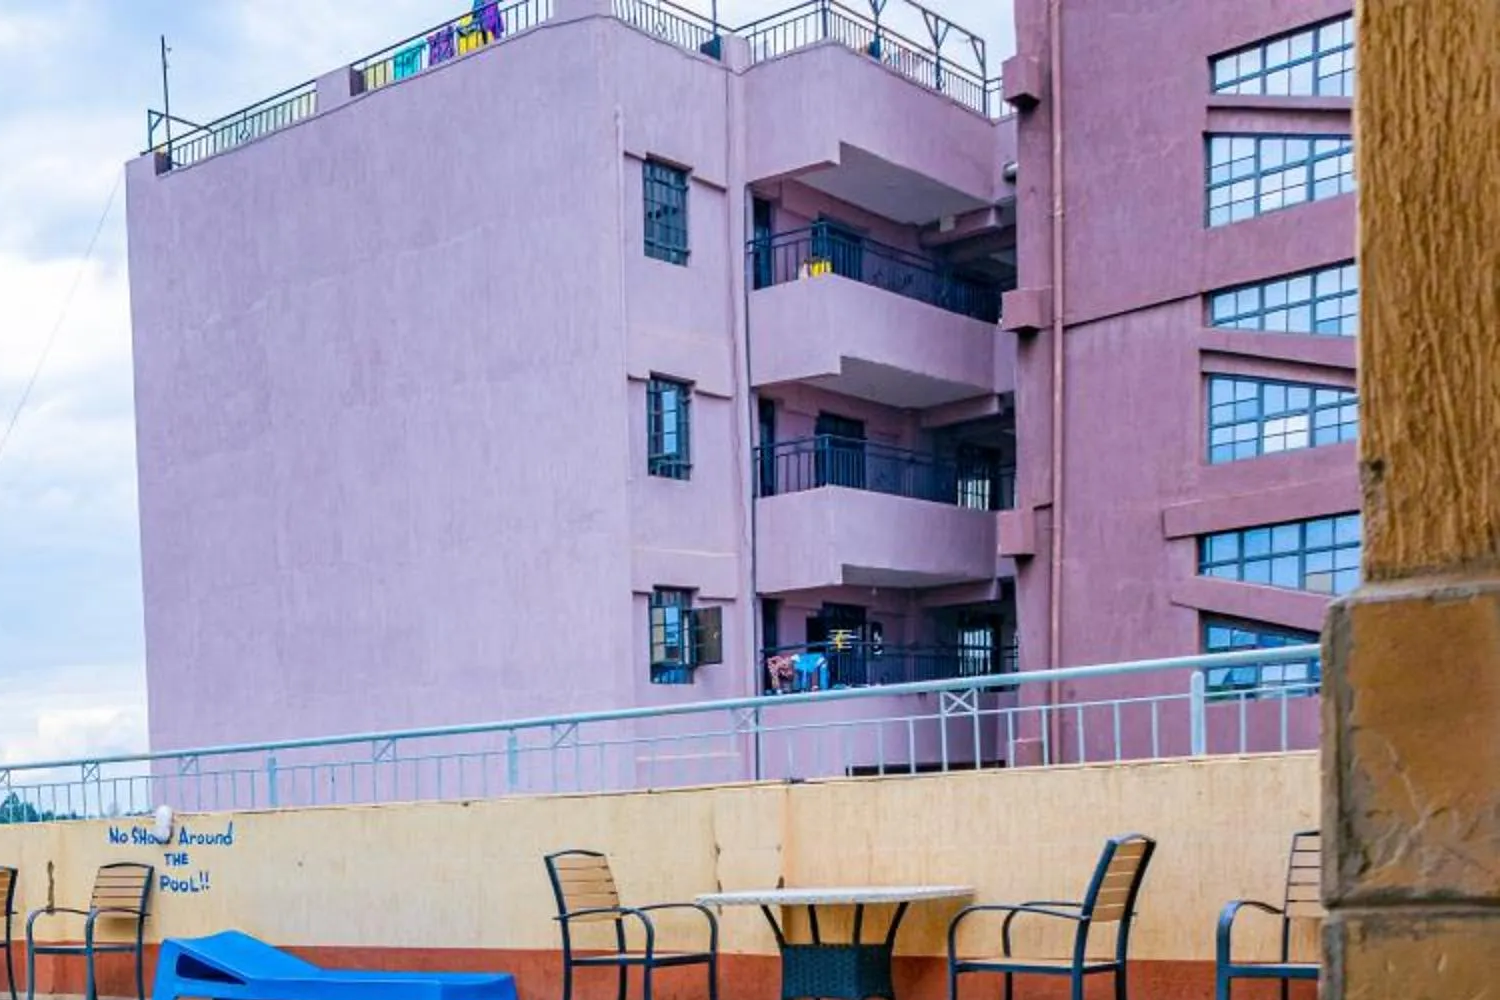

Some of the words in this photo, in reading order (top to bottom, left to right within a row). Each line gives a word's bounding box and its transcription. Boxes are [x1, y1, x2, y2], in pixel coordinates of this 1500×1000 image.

[109, 826, 129, 844] No
[178, 821, 234, 846] Around
[163, 852, 189, 866] THE
